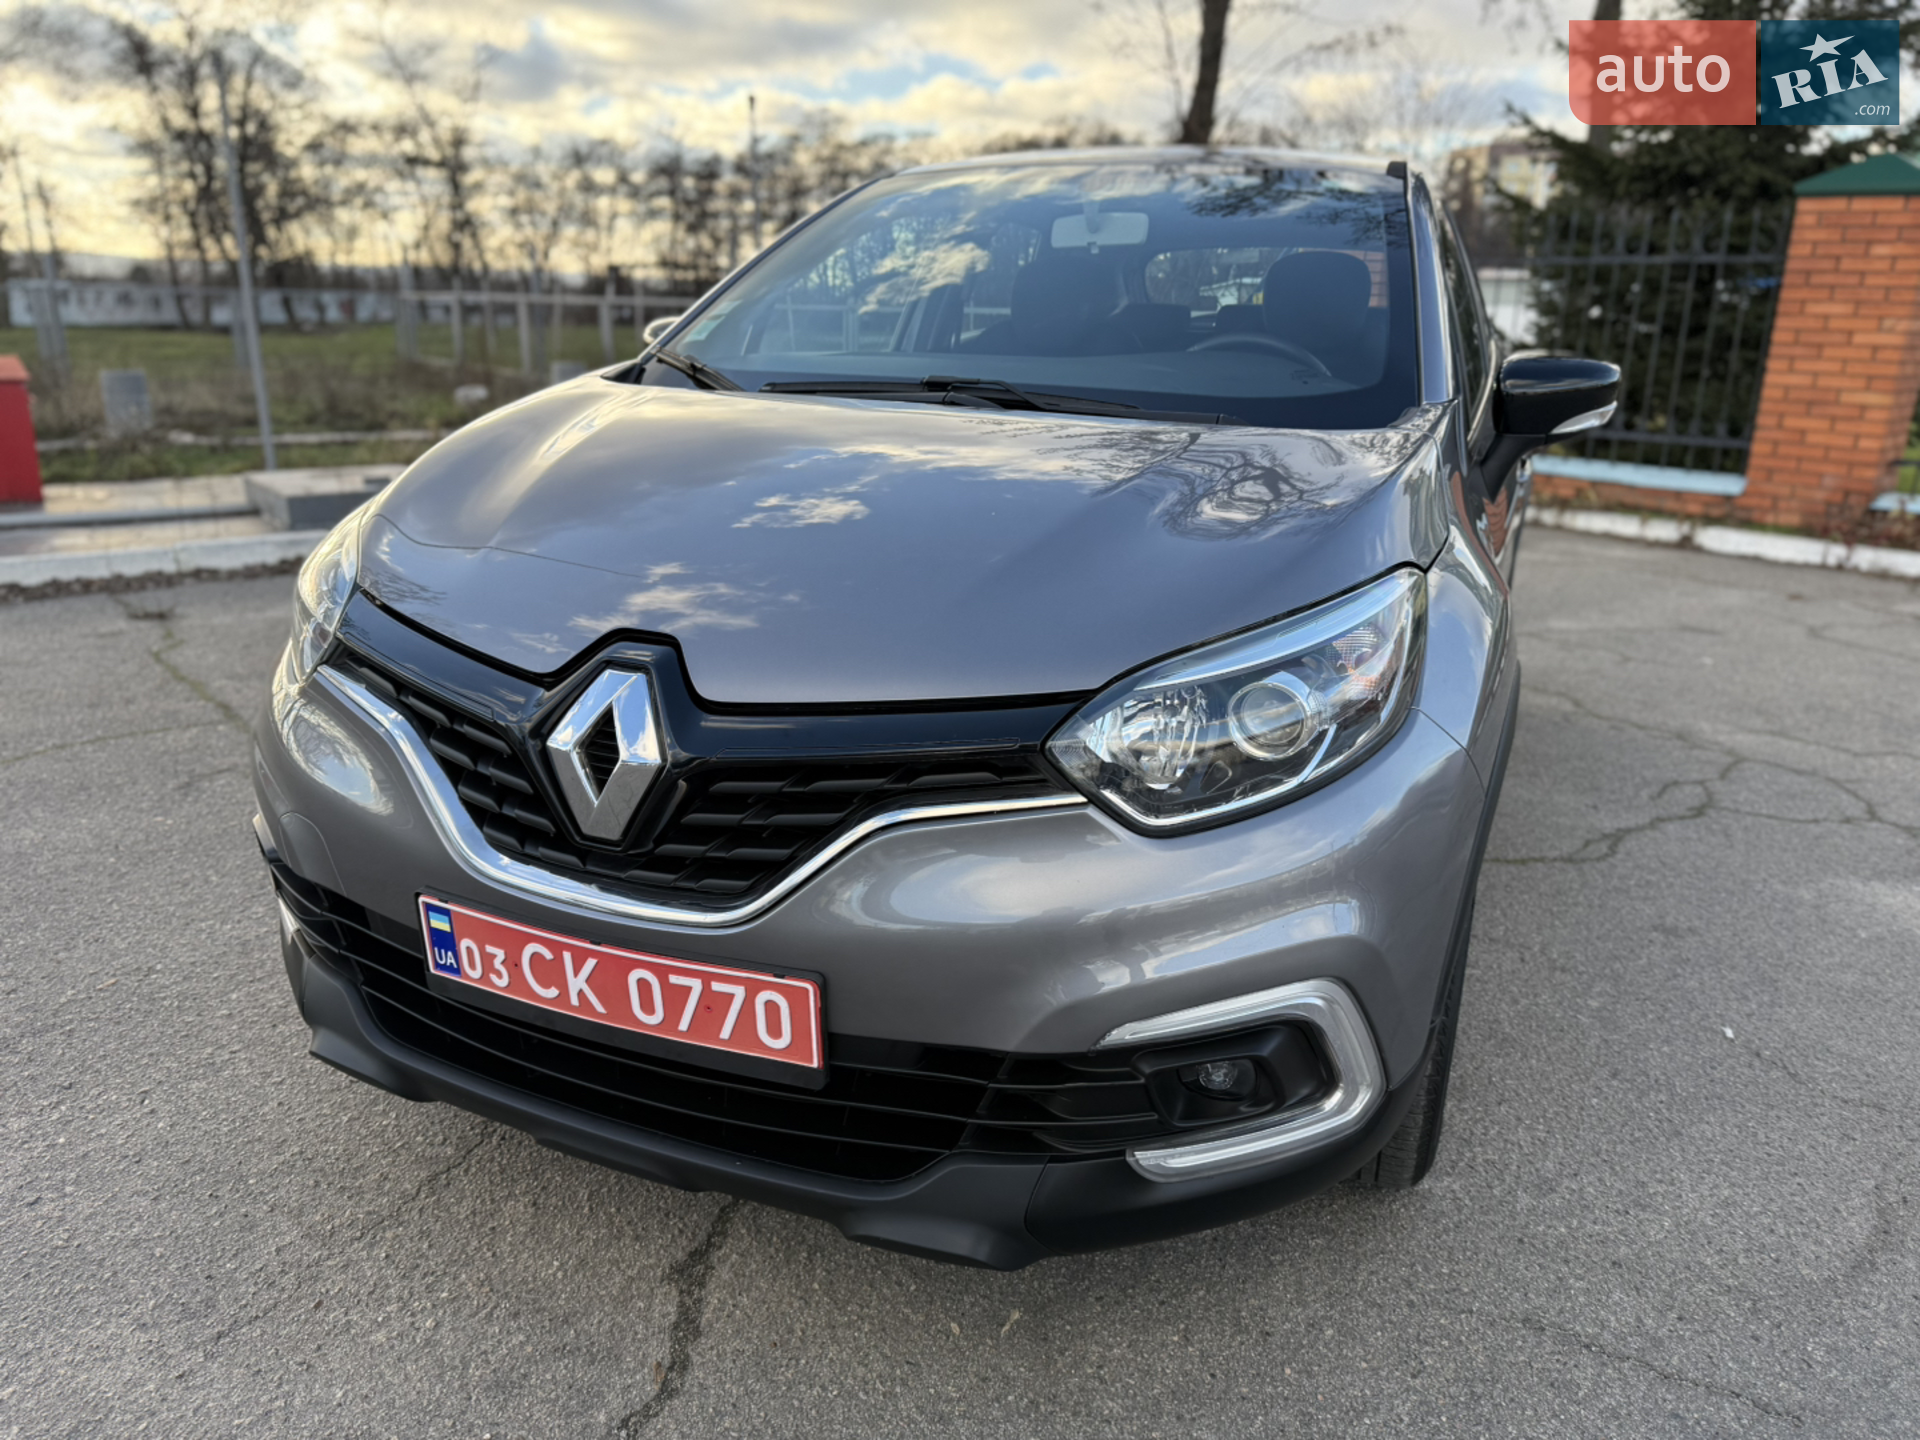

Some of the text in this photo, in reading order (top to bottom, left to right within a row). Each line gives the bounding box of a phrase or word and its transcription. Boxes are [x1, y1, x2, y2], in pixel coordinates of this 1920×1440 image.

[433, 946, 458, 969] UA
[459, 938, 792, 1050] 03 CK 0770
